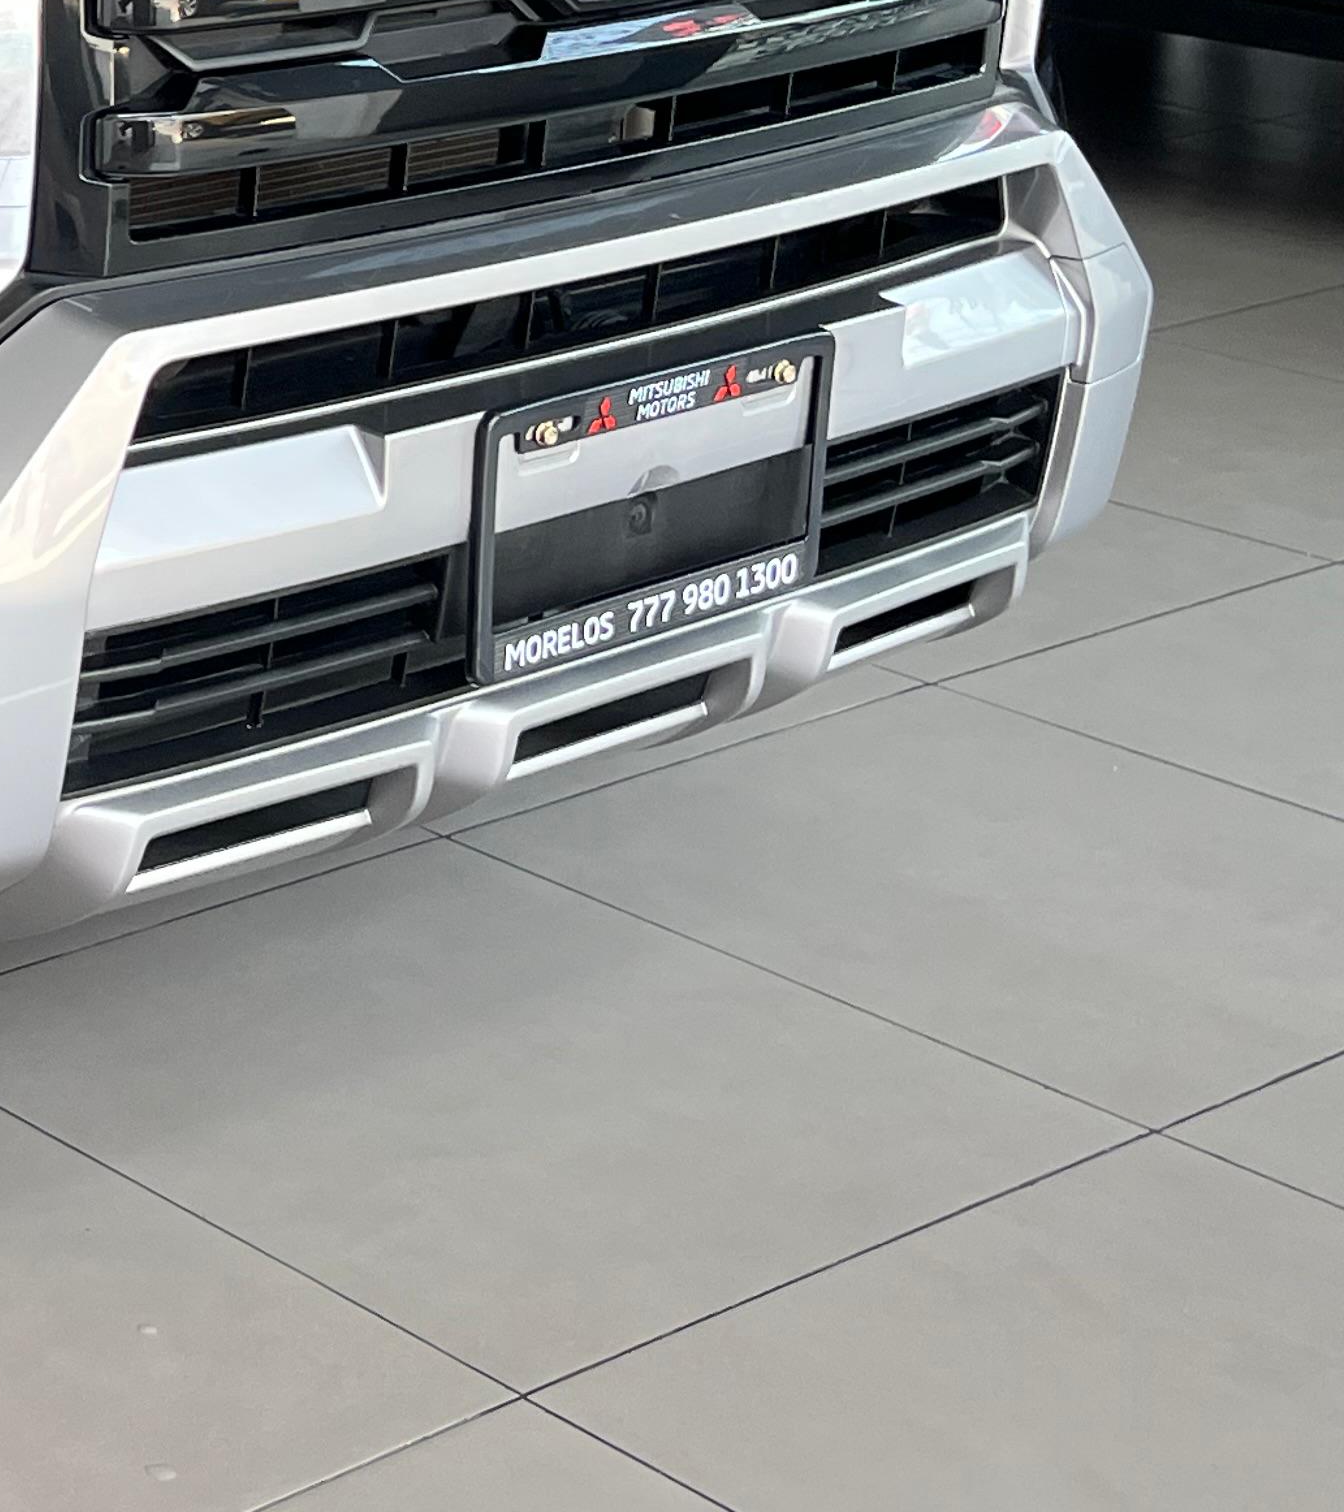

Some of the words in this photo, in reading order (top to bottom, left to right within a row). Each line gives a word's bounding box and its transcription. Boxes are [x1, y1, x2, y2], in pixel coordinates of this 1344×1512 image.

[627, 369, 711, 406] MITSUBISHI
[635, 390, 697, 421] MOTORS
[503, 611, 615, 672] MORELOS
[627, 590, 675, 634] 777
[681, 573, 731, 616] 980
[735, 553, 798, 599] 1300
